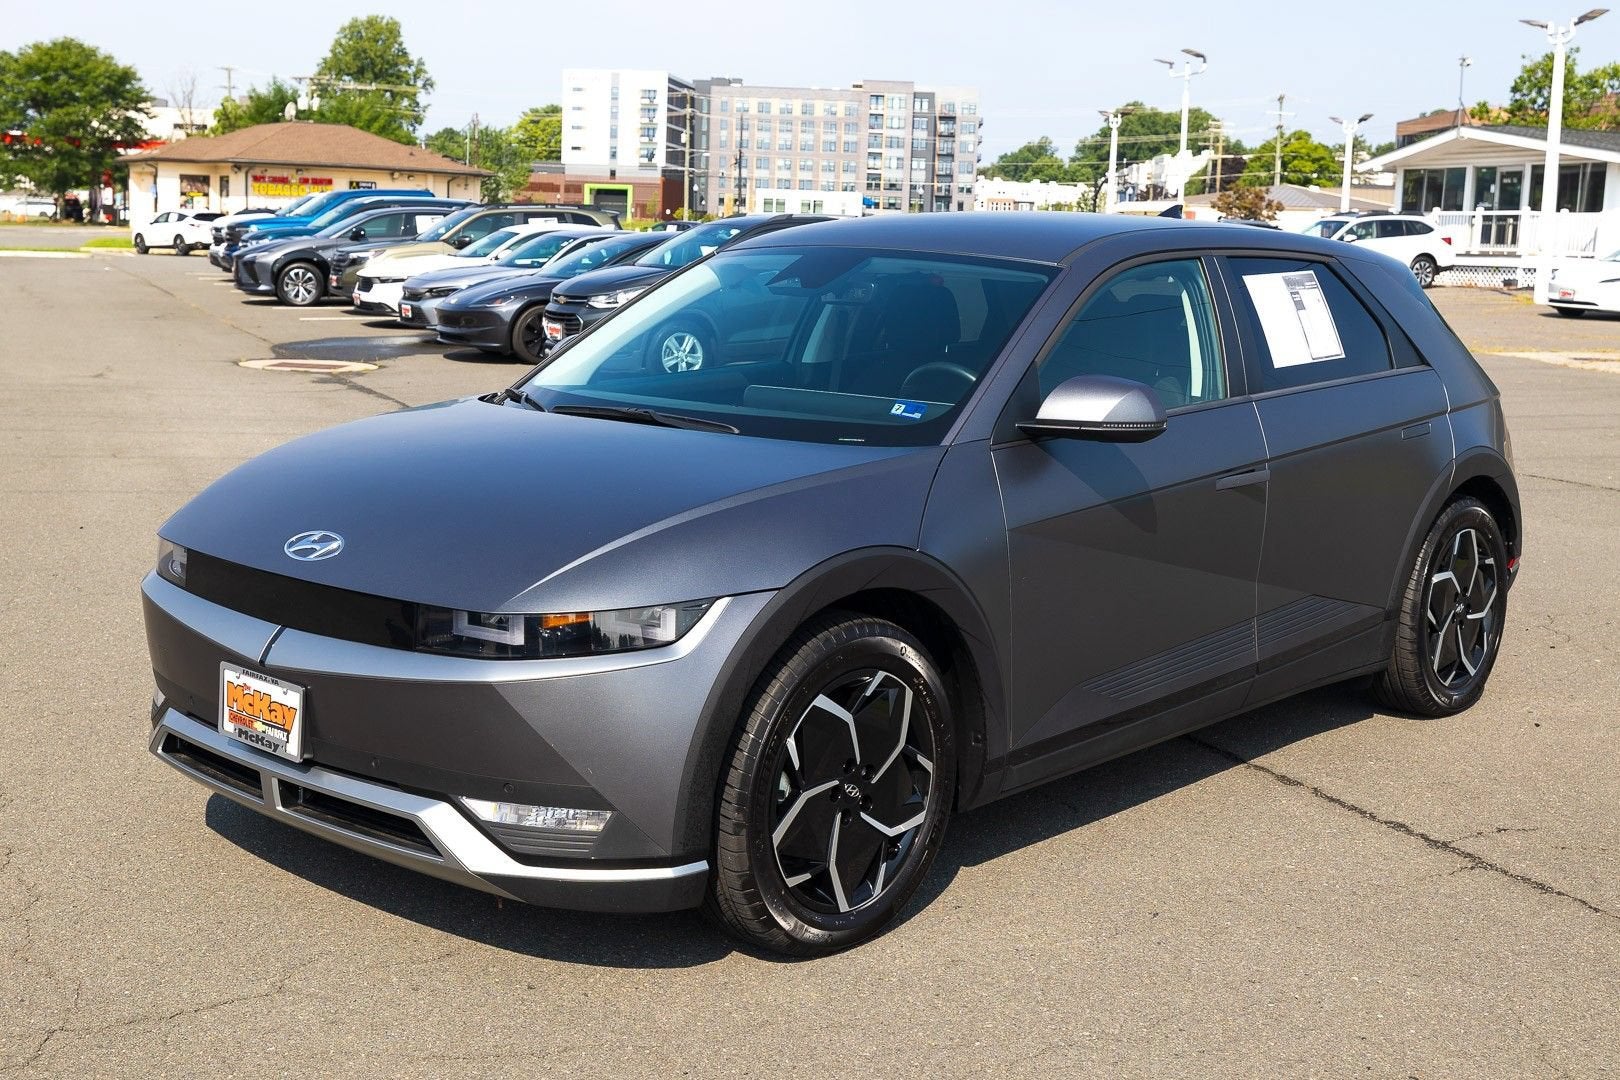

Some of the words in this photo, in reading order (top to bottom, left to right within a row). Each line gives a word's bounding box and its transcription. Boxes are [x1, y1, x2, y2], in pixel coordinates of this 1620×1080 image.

[251, 183, 307, 196] TOBACCO
[227, 681, 297, 733] McKay
[237, 727, 280, 753] McKay
